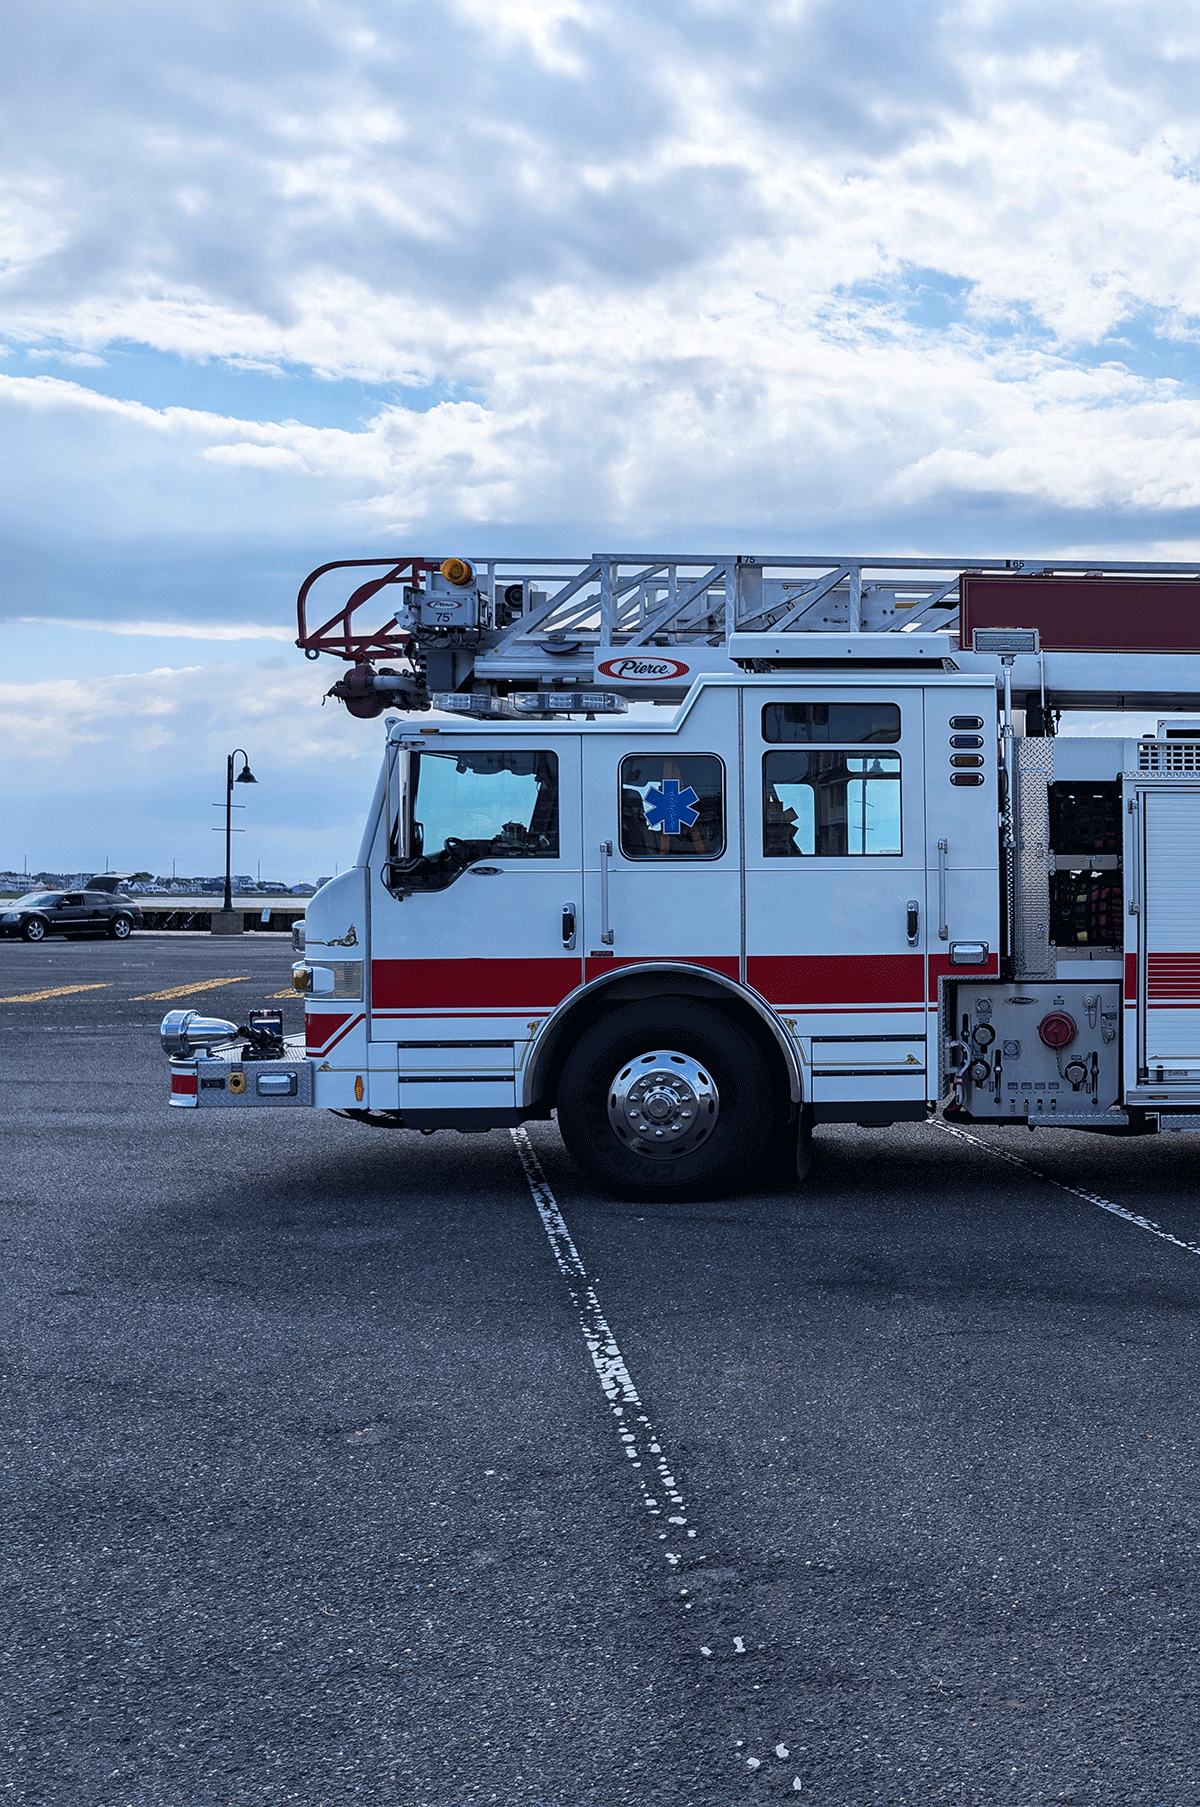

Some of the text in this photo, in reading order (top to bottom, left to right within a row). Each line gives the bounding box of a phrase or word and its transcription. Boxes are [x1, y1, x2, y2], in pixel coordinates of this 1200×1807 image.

[744, 556, 755, 564] 75
[1013, 560, 1024, 568] 65
[618, 660, 670, 676] Pierce
